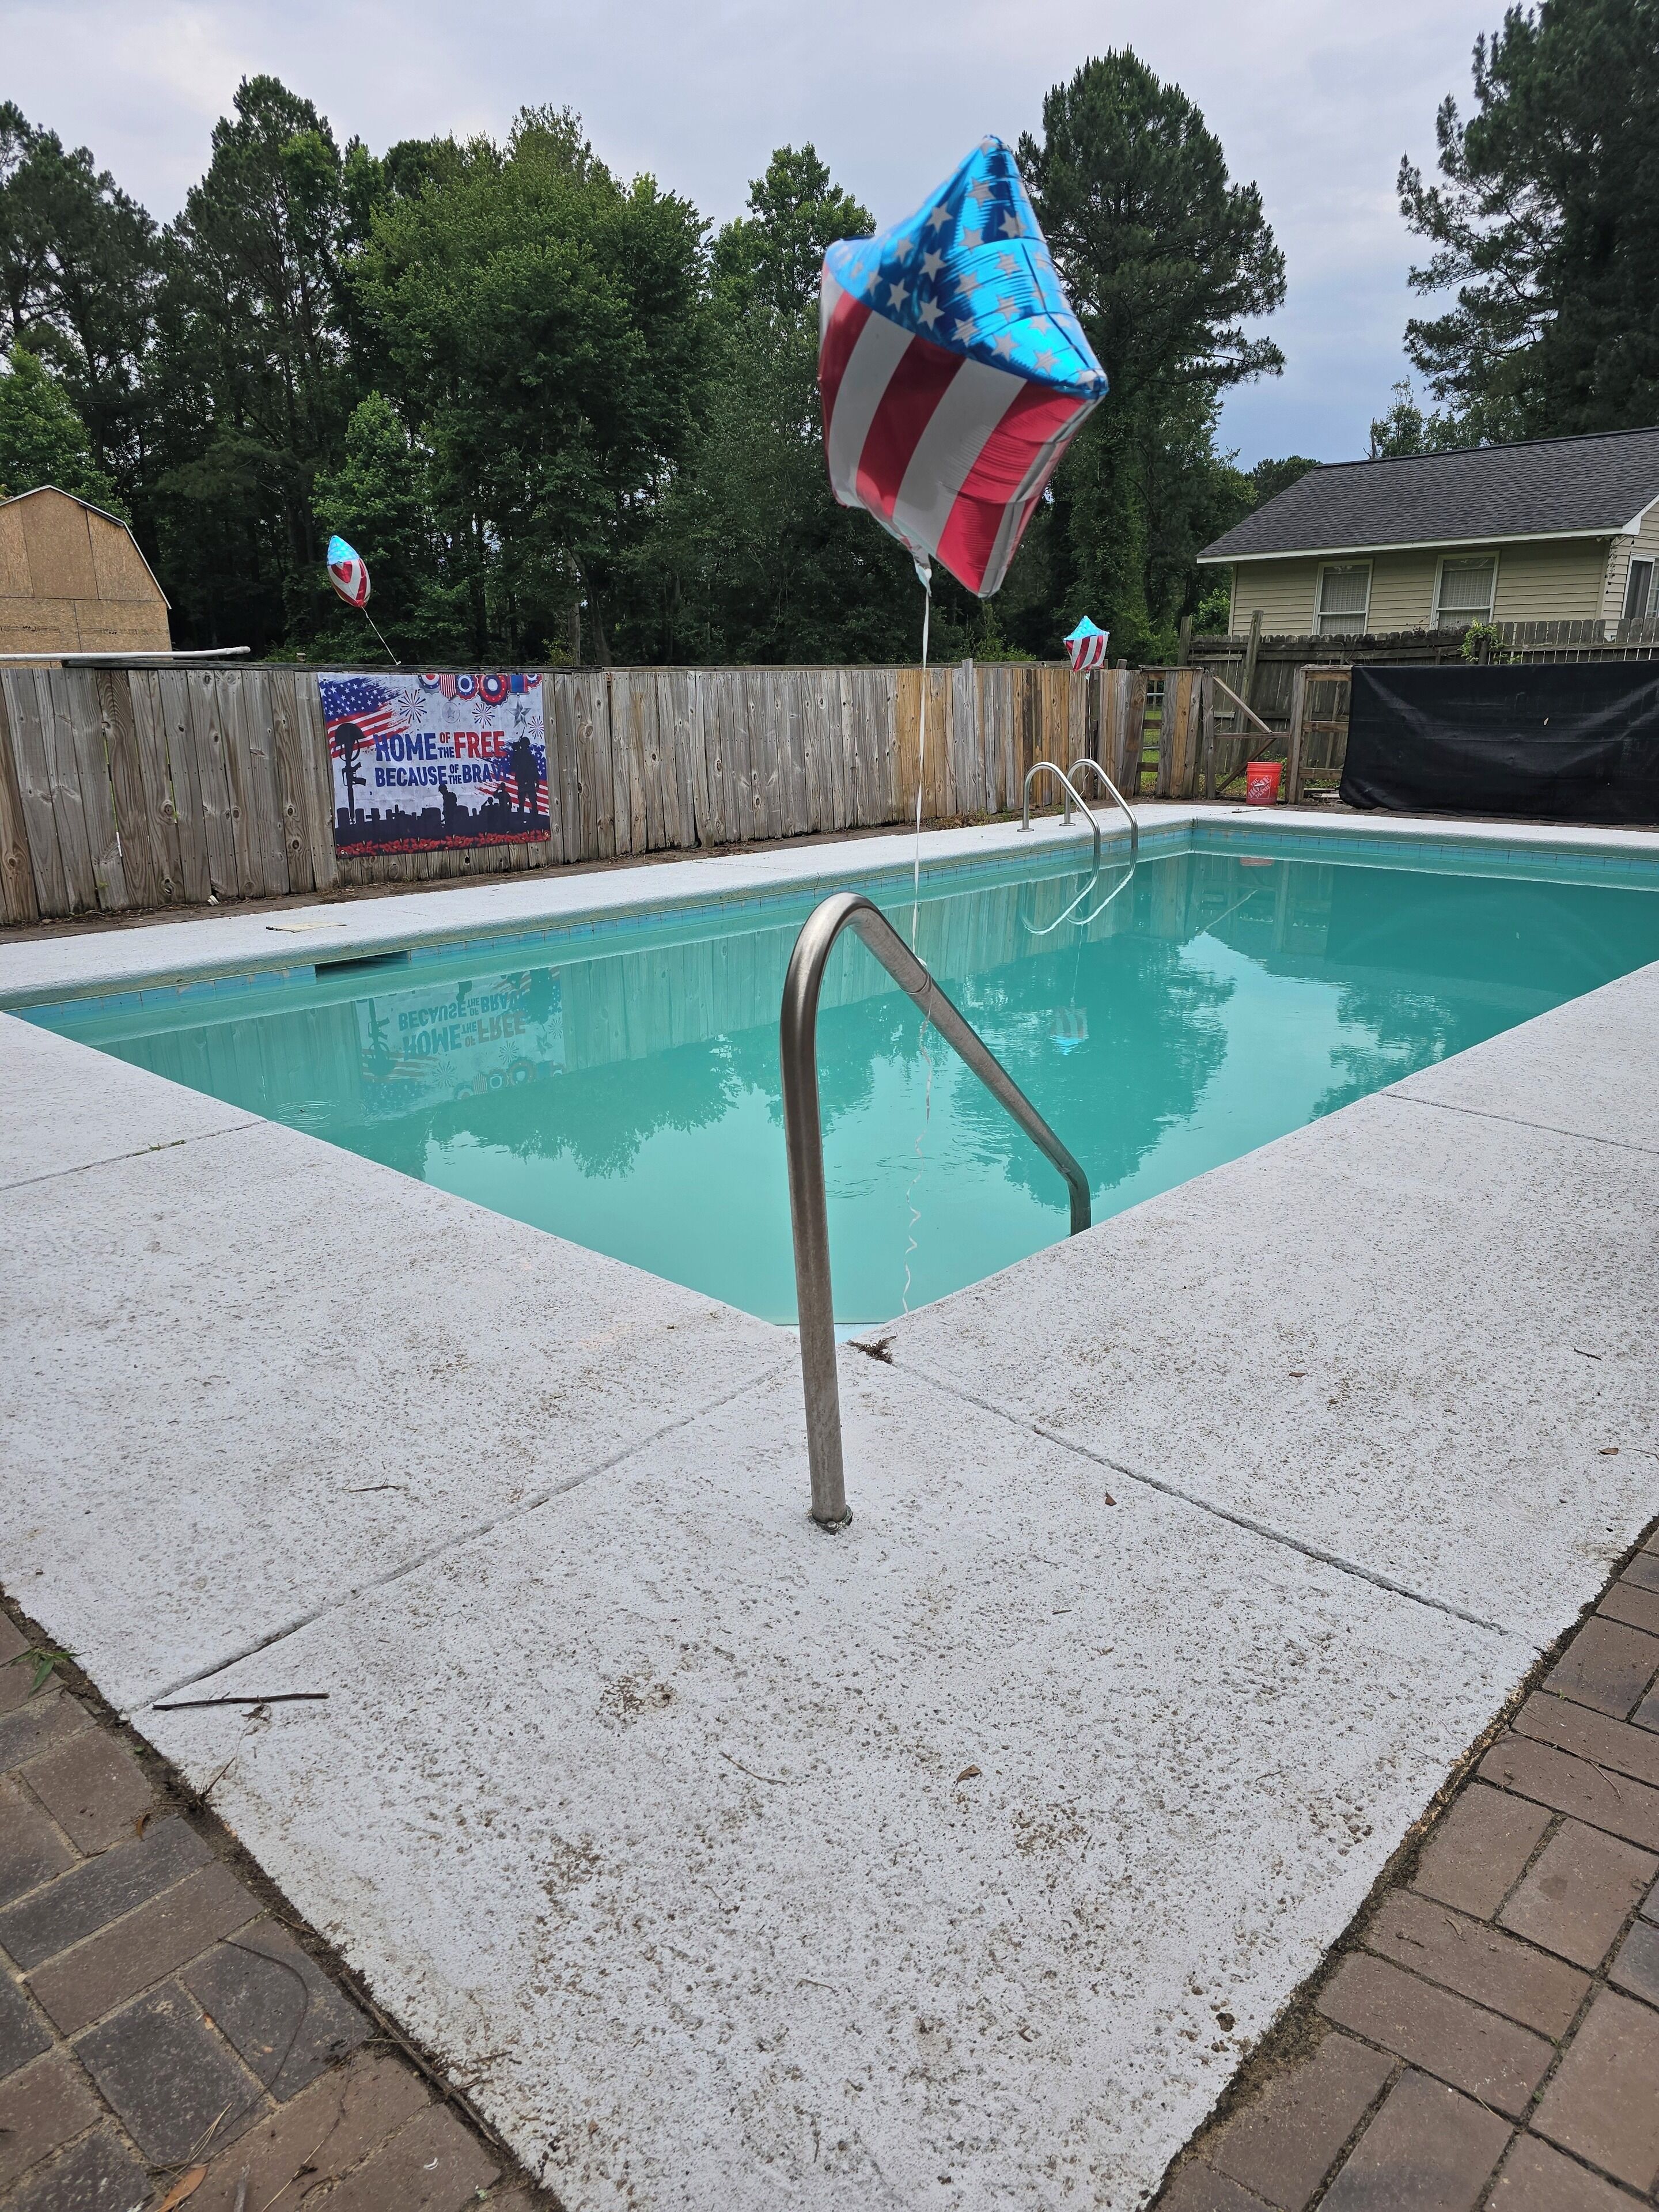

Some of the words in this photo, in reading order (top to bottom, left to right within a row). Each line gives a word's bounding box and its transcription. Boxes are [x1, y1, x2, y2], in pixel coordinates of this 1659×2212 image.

[439, 732, 450, 744] OF
[373, 733, 438, 762] HOME
[453, 731, 507, 759] FREE
[437, 747, 454, 759] THE
[449, 764, 459, 774] OF
[374, 766, 448, 787] BECAUSE
[448, 775, 461, 785] THE
